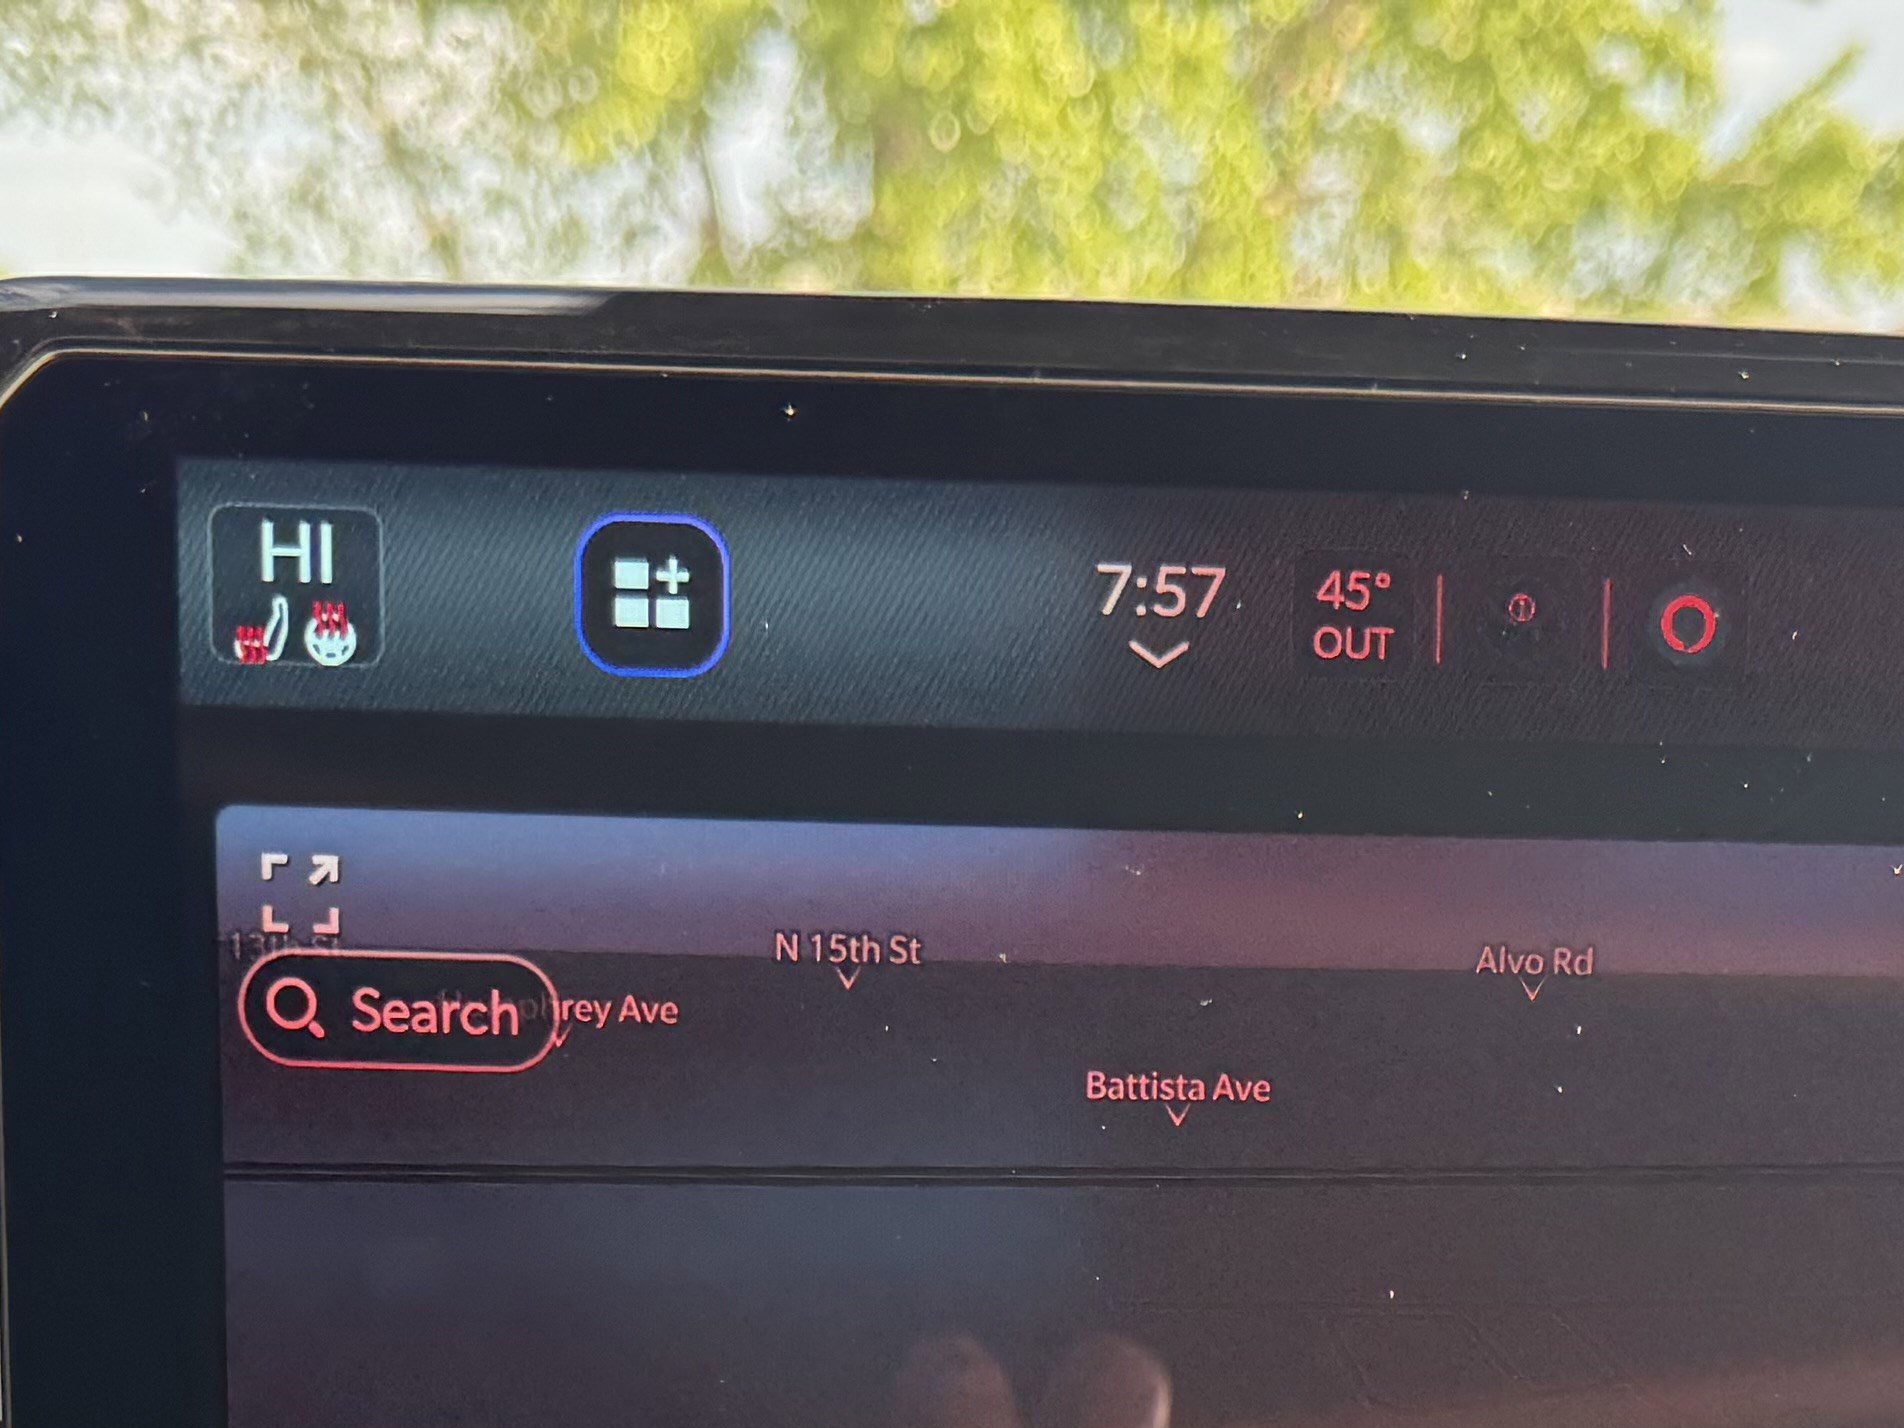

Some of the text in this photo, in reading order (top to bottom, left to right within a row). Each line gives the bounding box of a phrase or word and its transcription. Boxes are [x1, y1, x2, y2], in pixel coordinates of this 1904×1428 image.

[261, 520, 334, 584] HI
[1095, 562, 1227, 621] 7:57
[1313, 626, 1394, 661] OUT
[774, 933, 923, 965] N 15th St
[1475, 945, 1594, 977] Alvo Rd
[352, 987, 520, 1037] Search
[618, 995, 679, 1025] Ave
[1085, 1070, 1271, 1104] Battista Ave
